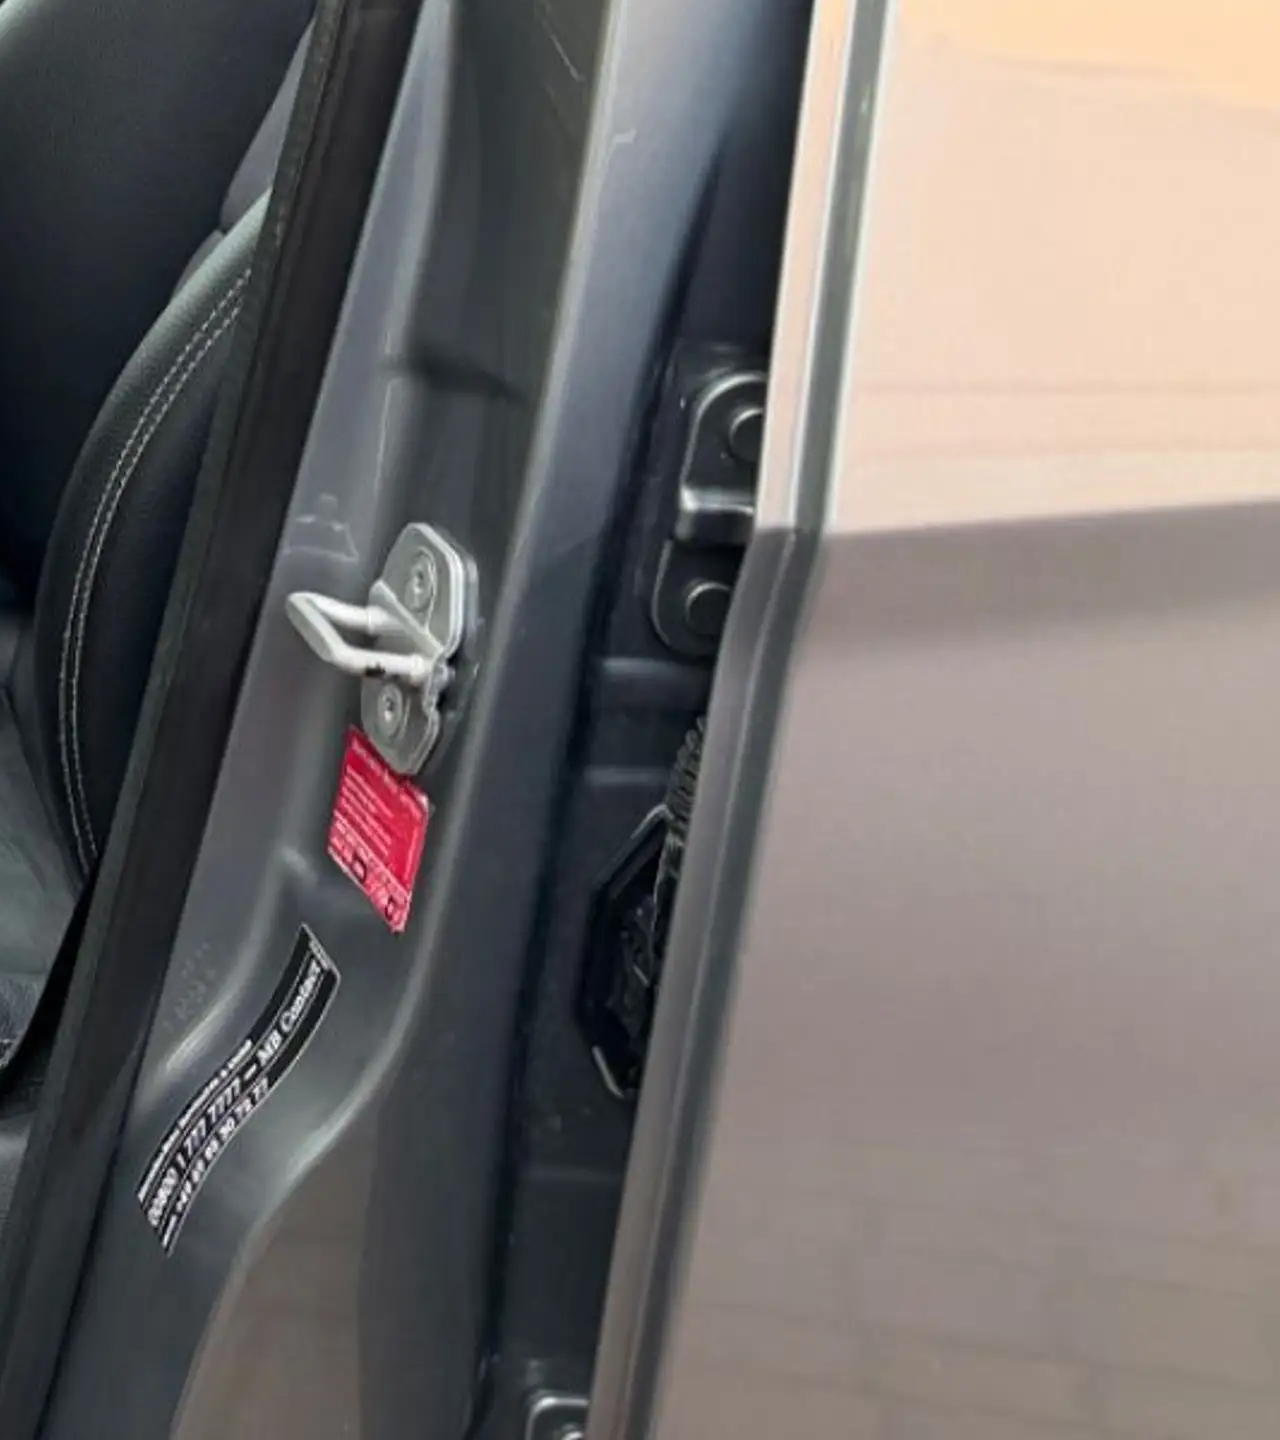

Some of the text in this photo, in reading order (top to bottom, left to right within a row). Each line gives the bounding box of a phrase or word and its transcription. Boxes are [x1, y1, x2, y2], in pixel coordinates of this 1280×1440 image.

[183, 1117, 206, 1157] 777
[206, 1077, 241, 1124] 7777
[256, 1028, 282, 1068] MB
[279, 959, 321, 1033] Contact
